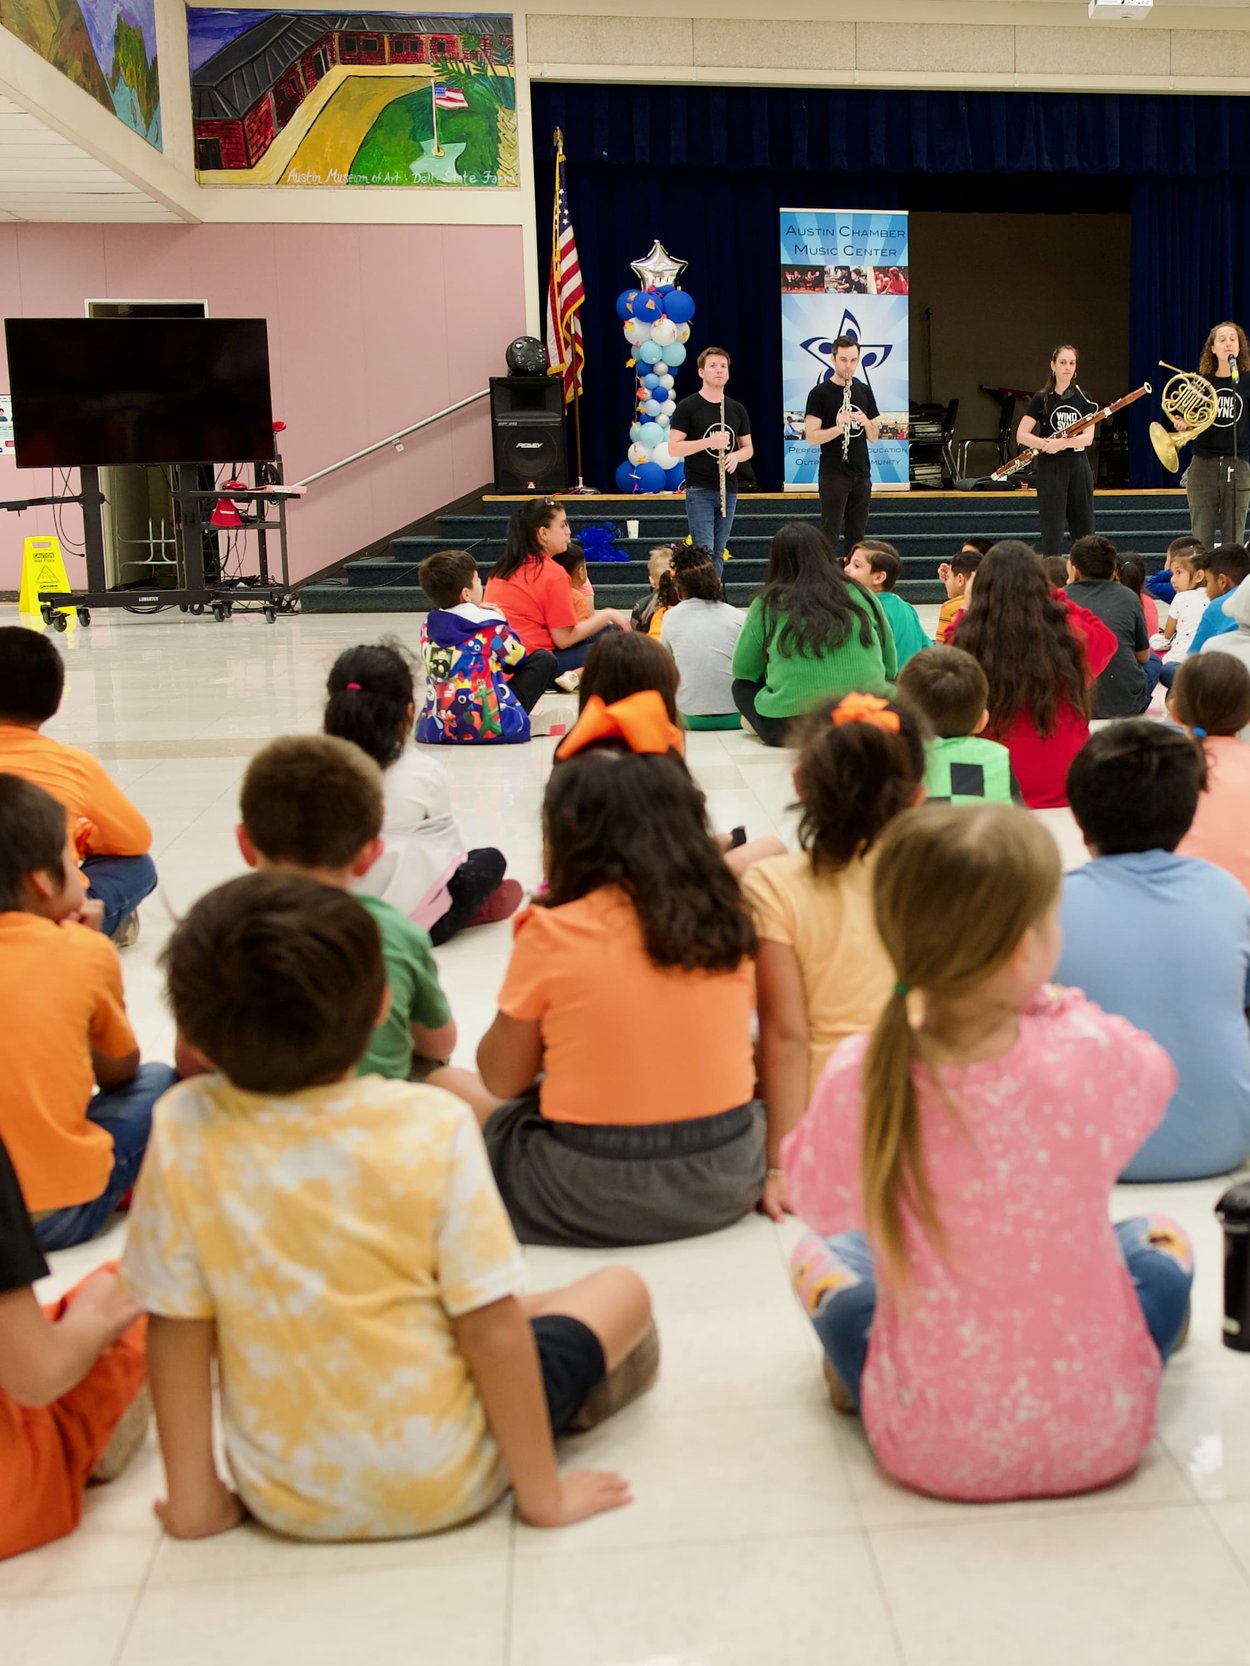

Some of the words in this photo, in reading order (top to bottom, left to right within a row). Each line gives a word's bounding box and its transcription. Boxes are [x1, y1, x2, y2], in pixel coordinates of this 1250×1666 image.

[286, 169, 323, 184] Austin
[324, 169, 369, 184] Museum
[371, 171, 382, 184] of
[383, 170, 400, 183] Art
[444, 171, 478, 184] State
[785, 225, 835, 237] AUSTIN
[839, 225, 905, 239] CHAMBER
[794, 244, 838, 256] MUSIC
[843, 245, 897, 257] CENTER
[1056, 411, 1078, 422] WIND
[868, 446, 908, 454] DUCATION
